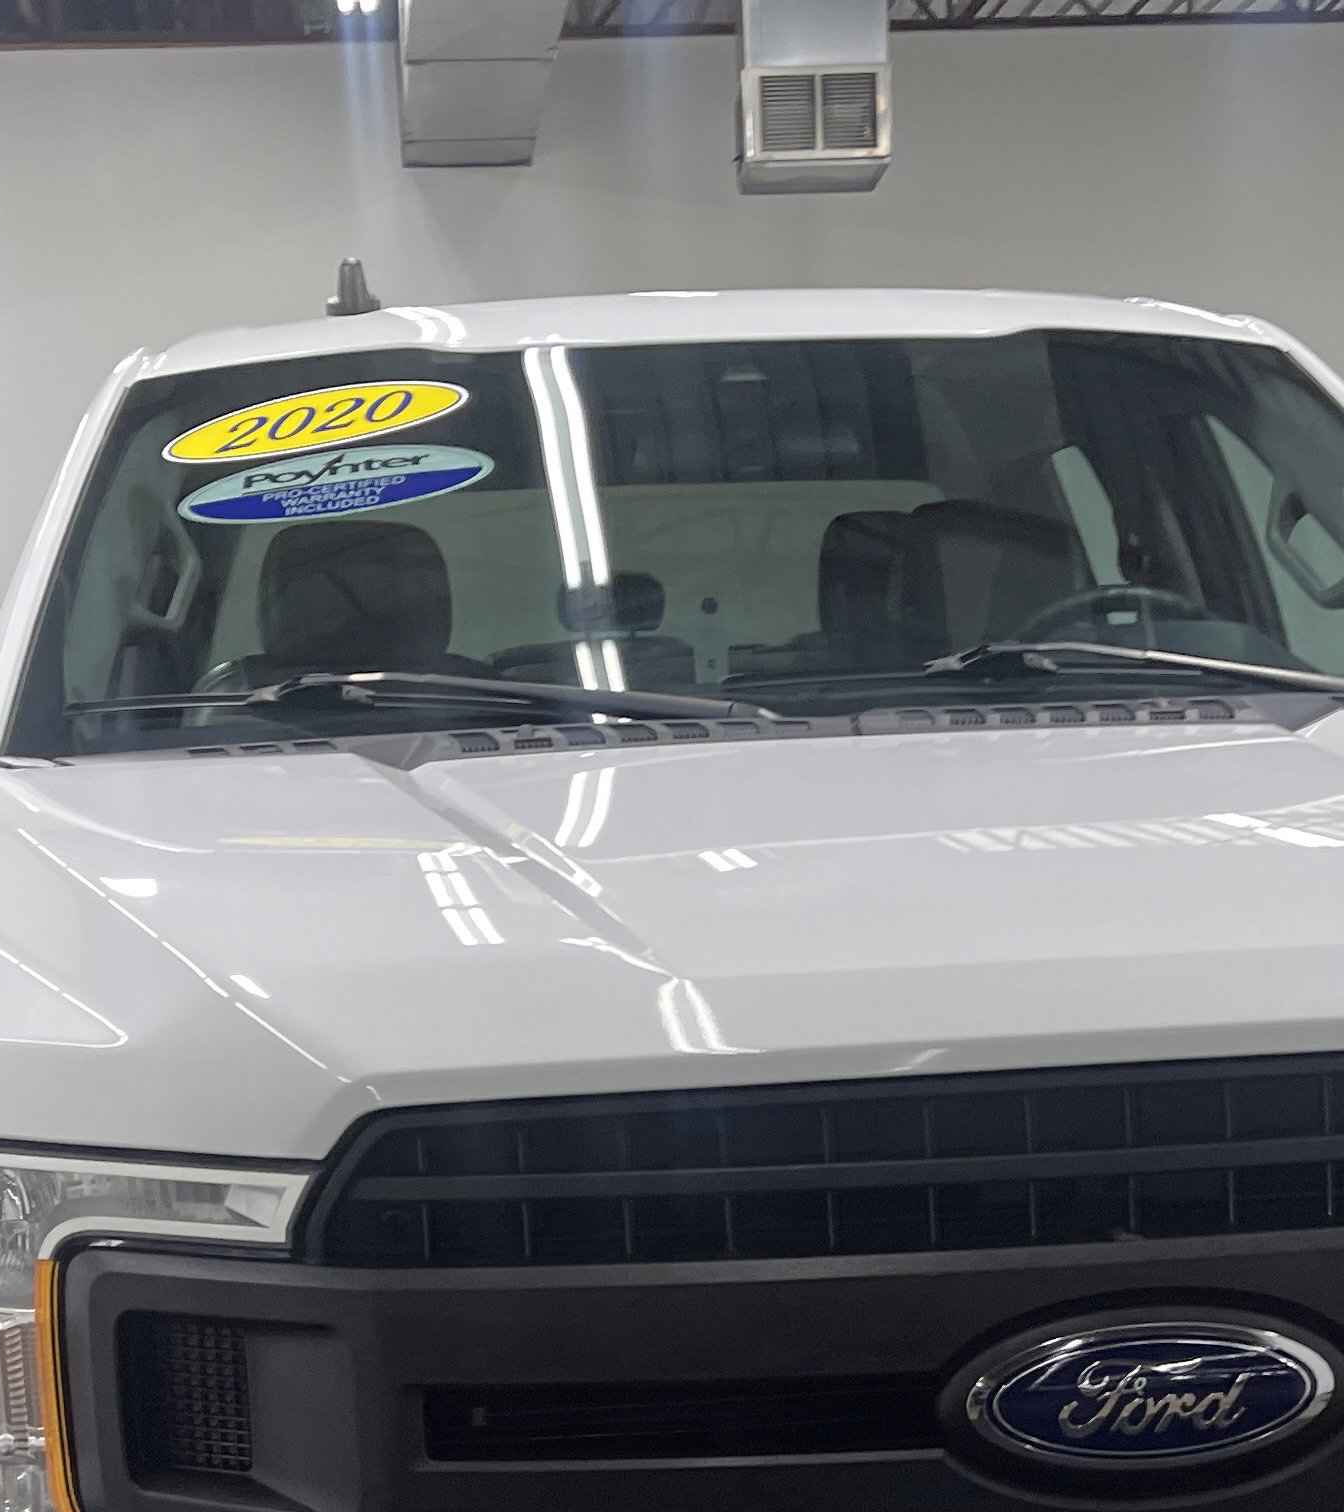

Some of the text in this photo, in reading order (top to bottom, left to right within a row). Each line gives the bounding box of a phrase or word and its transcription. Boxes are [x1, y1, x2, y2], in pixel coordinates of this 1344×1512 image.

[215, 390, 413, 453] 2020
[242, 453, 430, 489] Poynter
[262, 475, 406, 502] PRO-CERTIFIED
[280, 486, 384, 508] WARRANTY
[284, 495, 380, 516] INCLUDED
[1058, 1358, 1249, 1438] Ford
